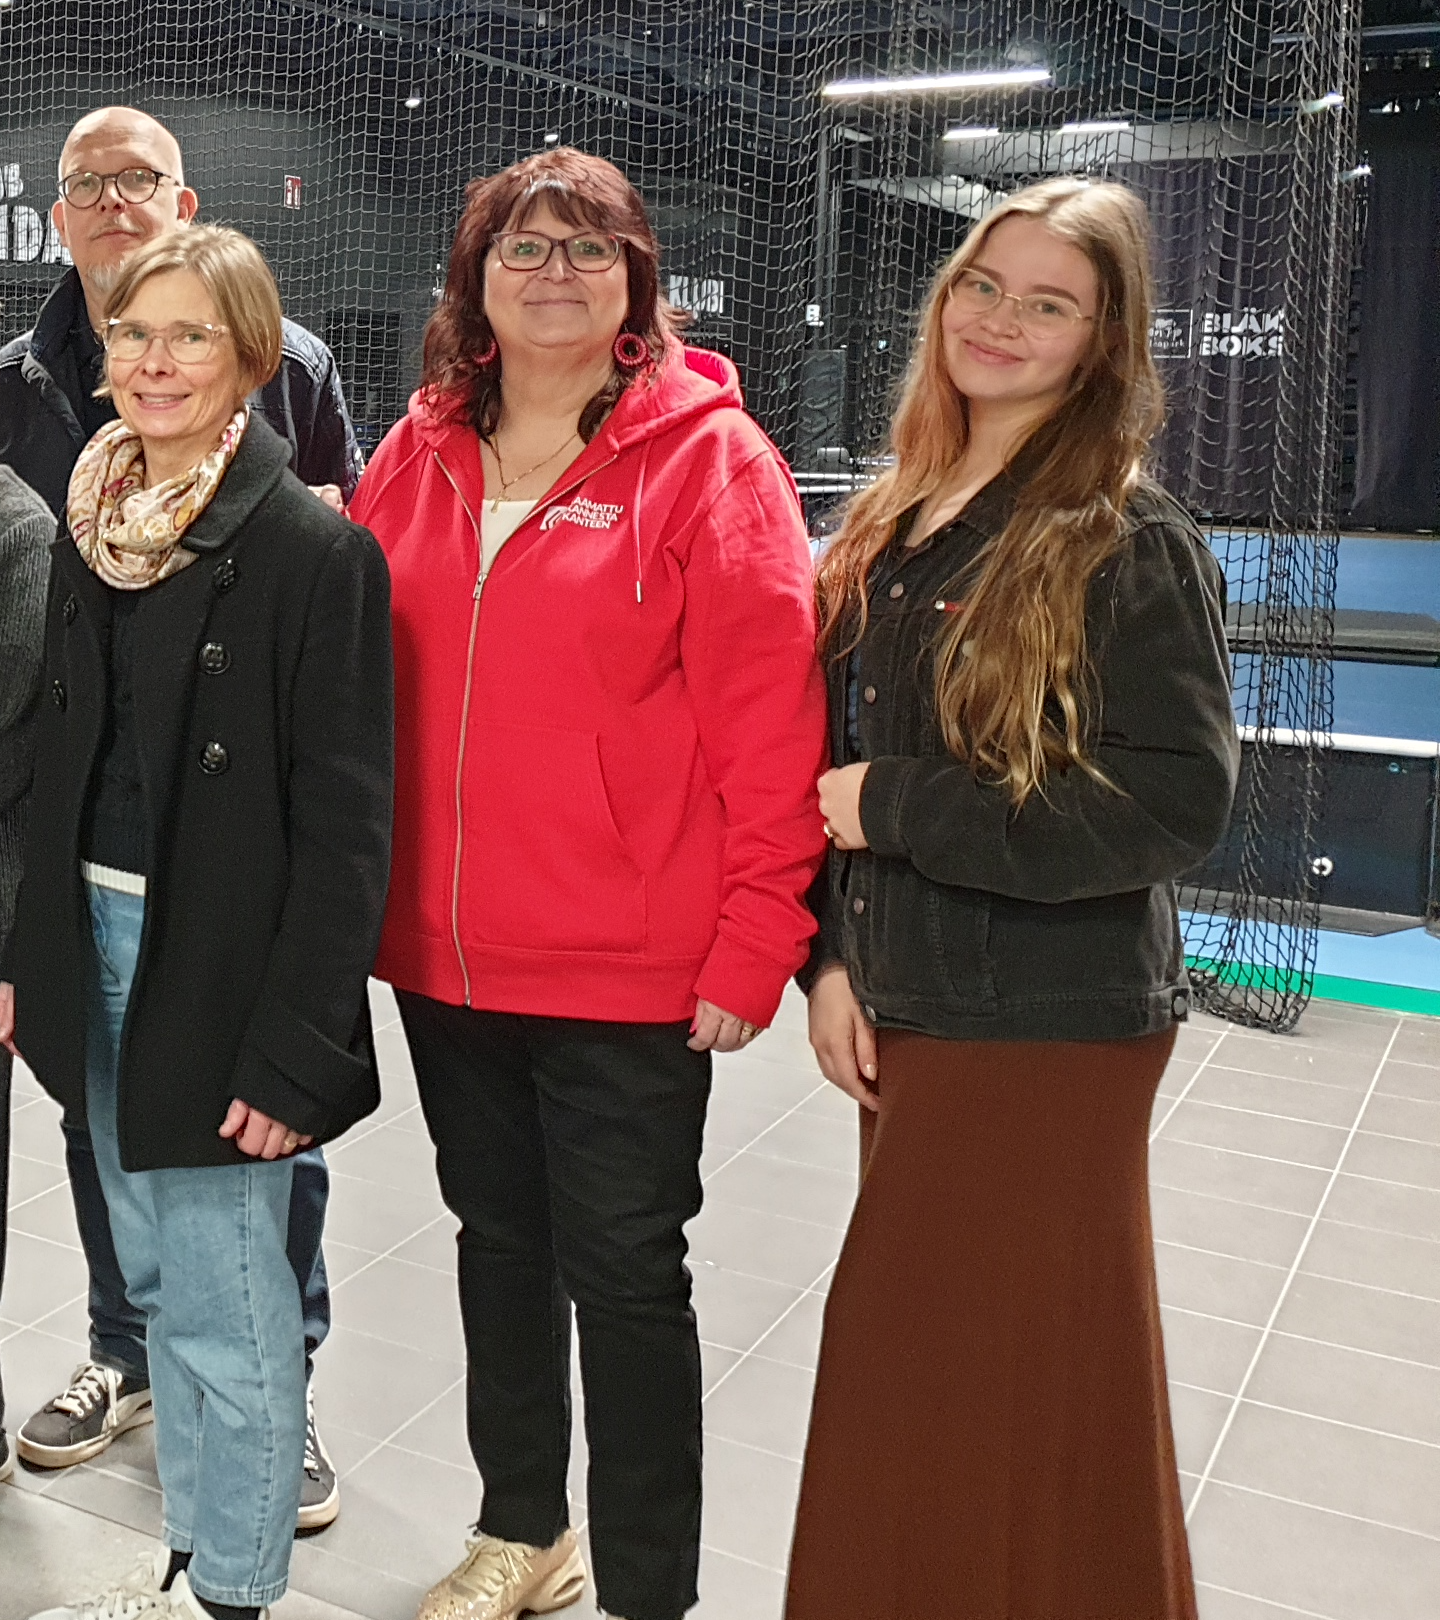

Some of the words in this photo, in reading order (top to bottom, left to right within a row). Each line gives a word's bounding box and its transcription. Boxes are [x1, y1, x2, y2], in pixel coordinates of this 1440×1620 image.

[1199, 335, 1284, 357] BOKS
[571, 496, 624, 514] AAMATTU
[562, 512, 611, 529] KANTEEN
